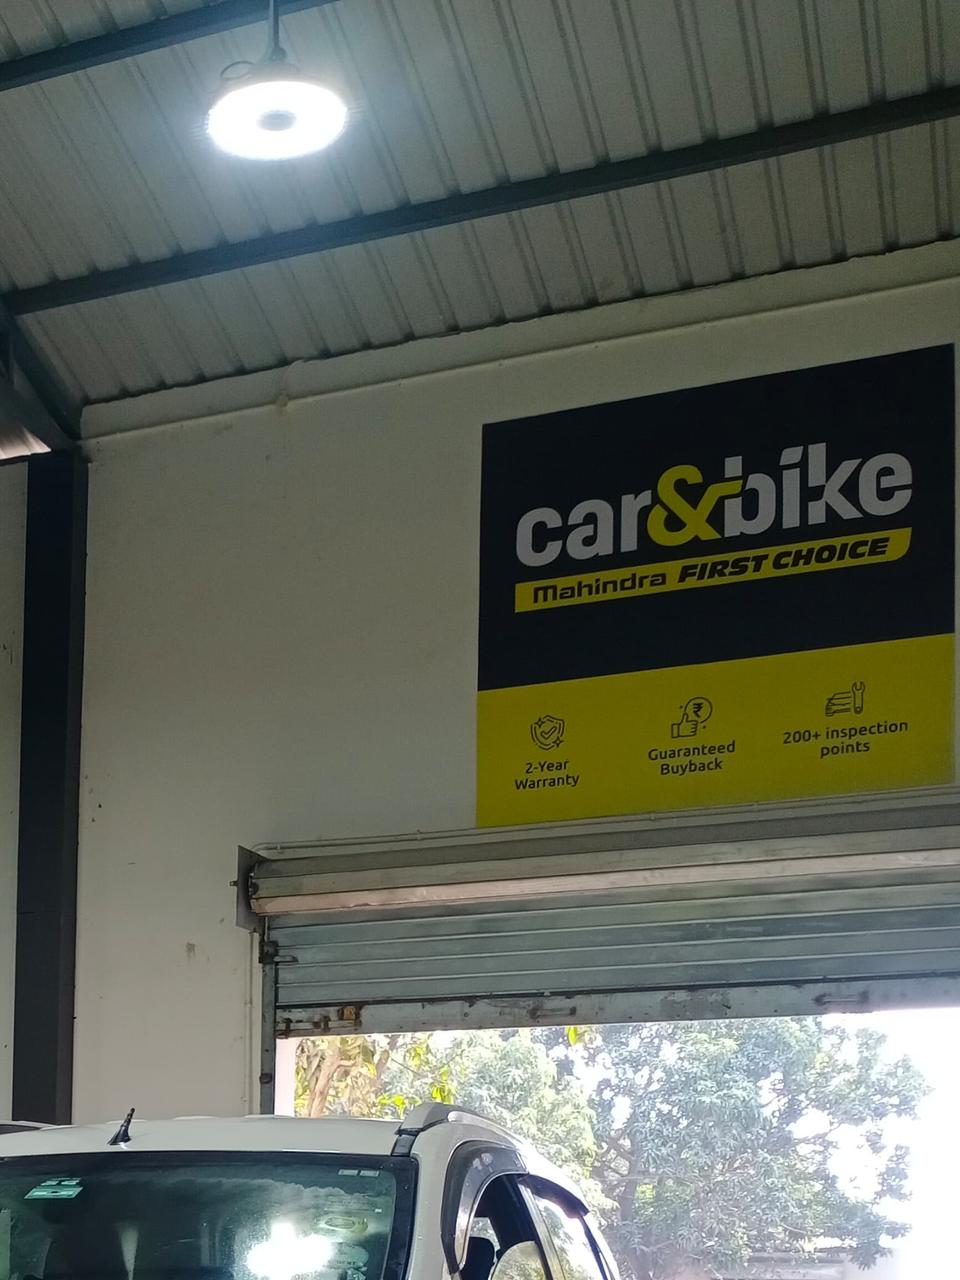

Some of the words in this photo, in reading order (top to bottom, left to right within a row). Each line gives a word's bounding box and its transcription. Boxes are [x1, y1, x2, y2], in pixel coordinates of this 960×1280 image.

[516, 443, 913, 567] car&bike
[533, 572, 667, 604] Mahindra
[678, 554, 768, 584] FIRST
[772, 537, 890, 570] CHOICE
[783, 729, 822, 745] 200+
[826, 720, 909, 741] inspection
[648, 740, 736, 761] Guaranteed
[820, 741, 870, 759] points
[525, 760, 570, 774] 2-Year
[660, 758, 723, 776] Buyback
[515, 773, 580, 790] Warranty
